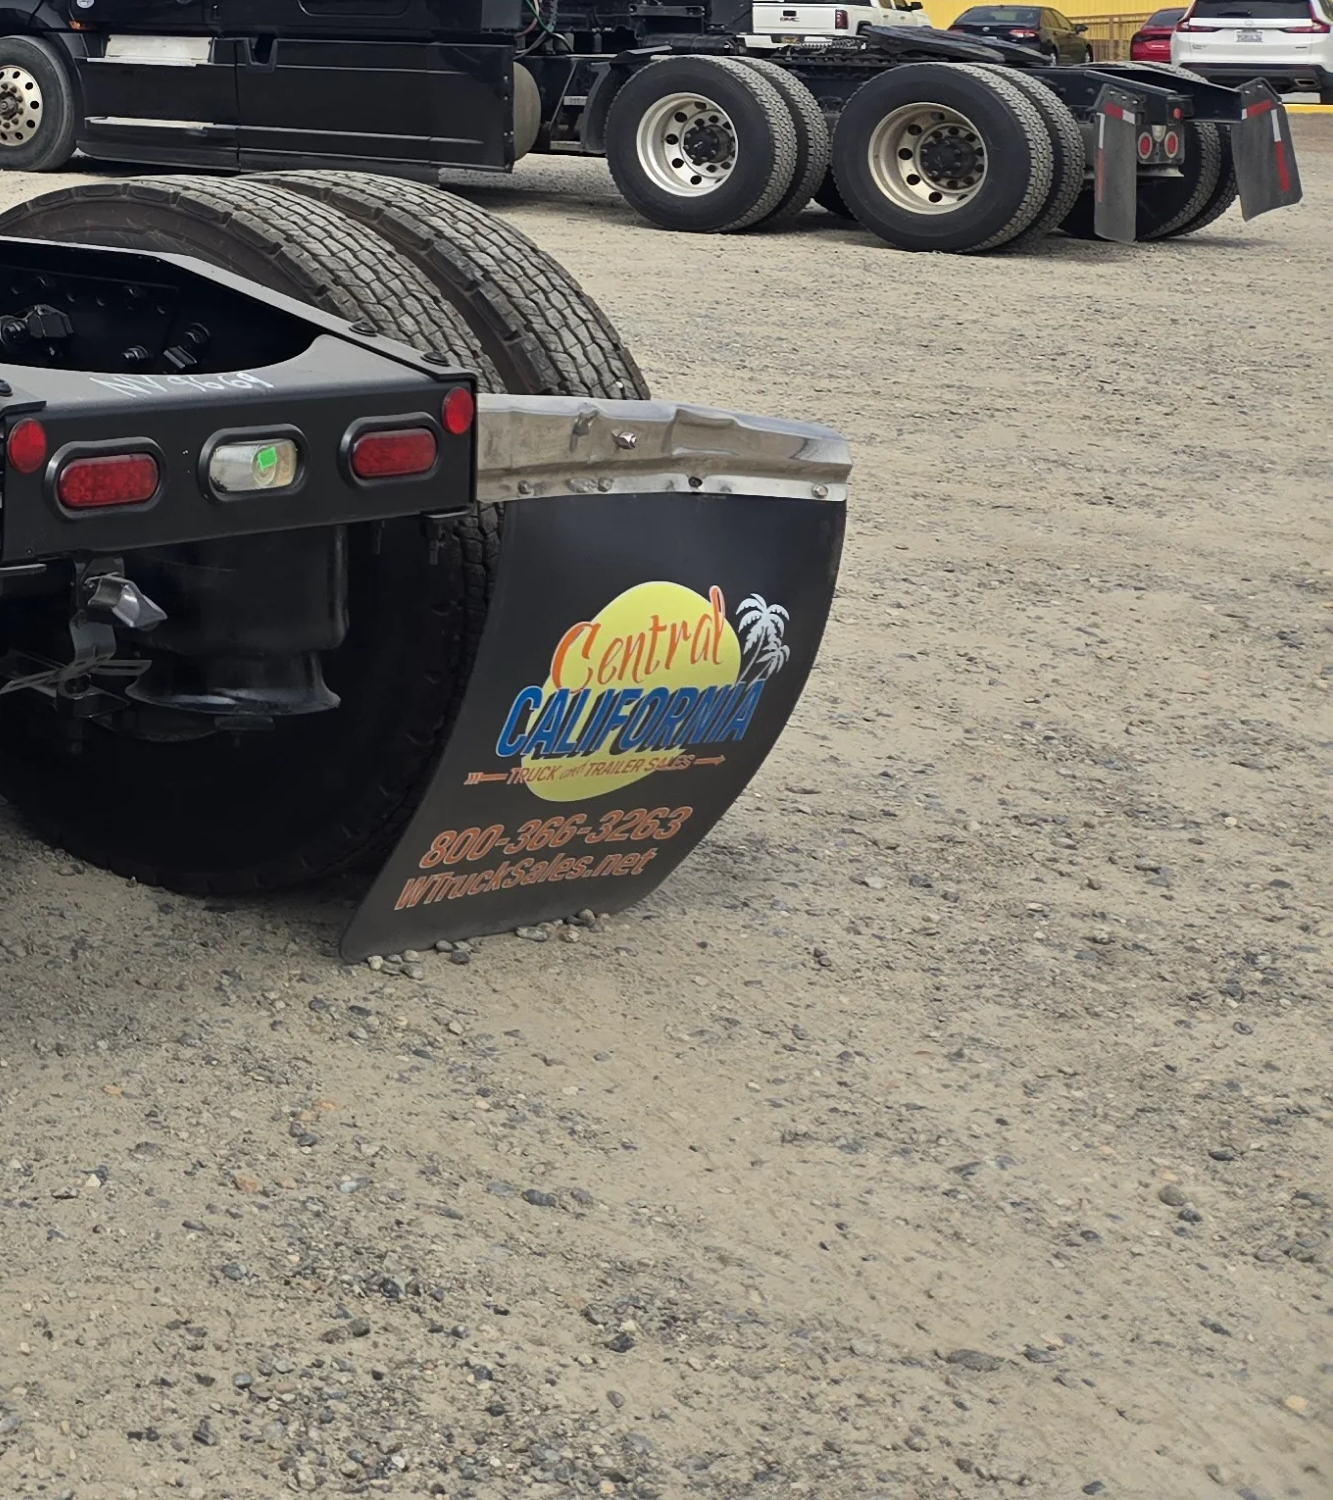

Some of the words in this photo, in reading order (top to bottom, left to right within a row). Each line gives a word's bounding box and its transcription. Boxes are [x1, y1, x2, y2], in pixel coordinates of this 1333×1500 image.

[167, 372, 274, 392] 9669
[551, 585, 725, 693] Central
[495, 679, 766, 758] CALIFORNIA
[507, 764, 558, 785] TRUCK
[584, 757, 645, 777] TRAILER
[644, 754, 696, 771] SALES
[419, 806, 693, 869] 800-366-3263
[394, 848, 658, 911] WTruckSales.net
